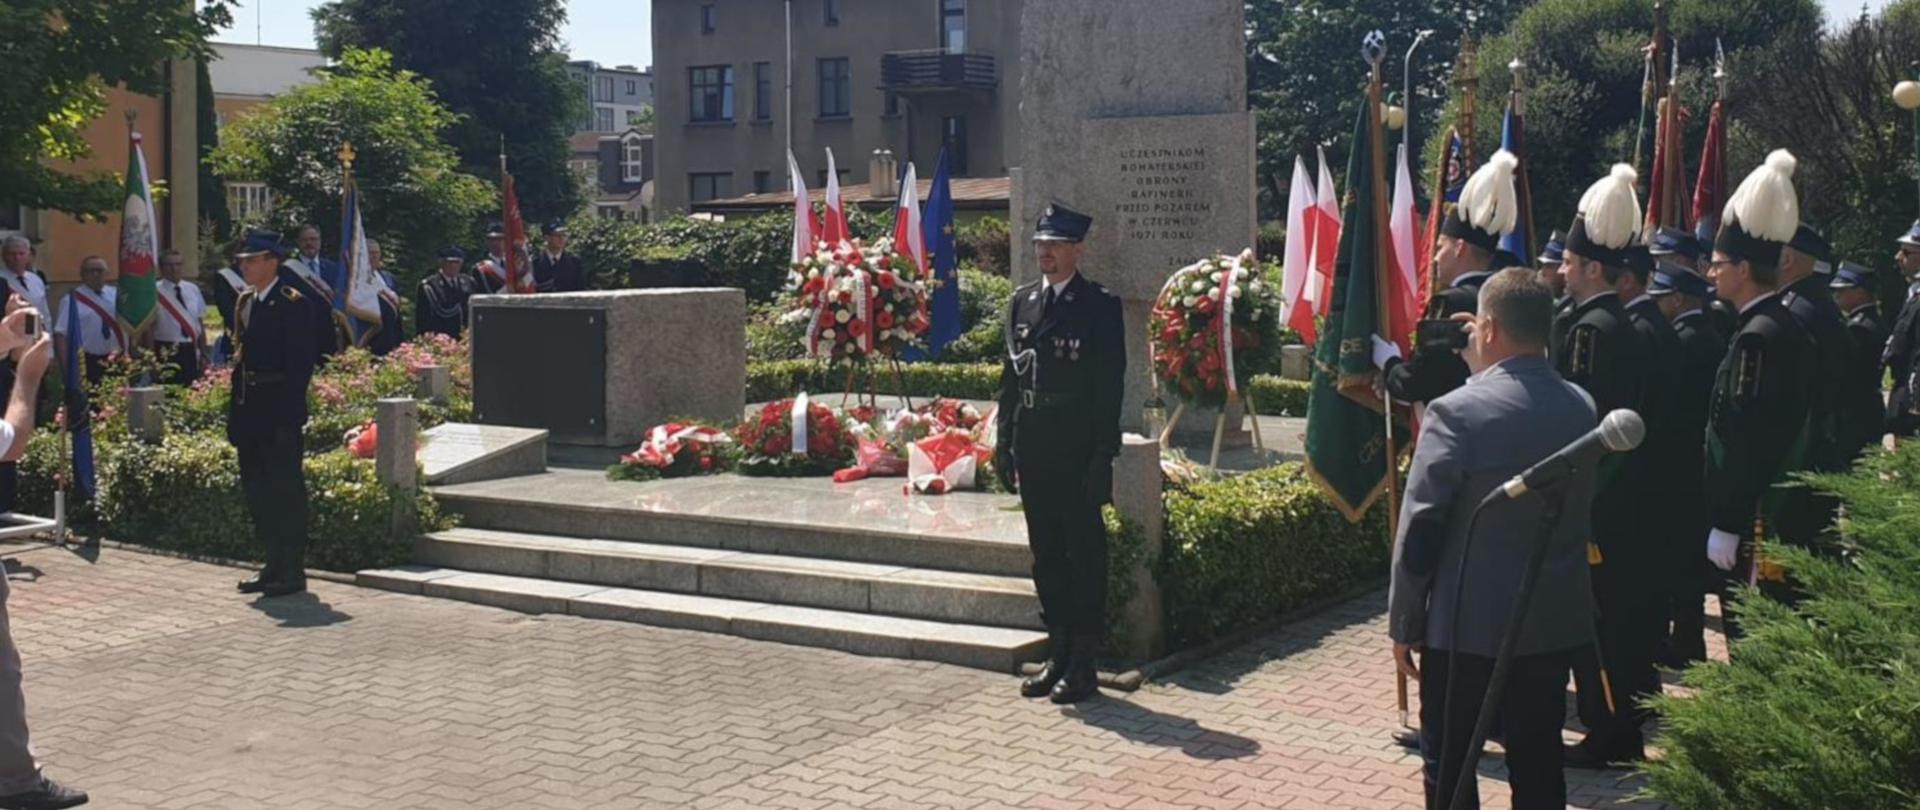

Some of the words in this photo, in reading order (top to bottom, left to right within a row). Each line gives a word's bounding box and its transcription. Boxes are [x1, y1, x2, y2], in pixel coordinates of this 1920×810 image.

[1136, 176, 1187, 185] OBRONY
[1131, 190, 1193, 199] RAFINERII
[1115, 204, 1149, 212] PRZED
[1142, 217, 1198, 226] CZERWCU
[1161, 230, 1194, 239] ROKU
